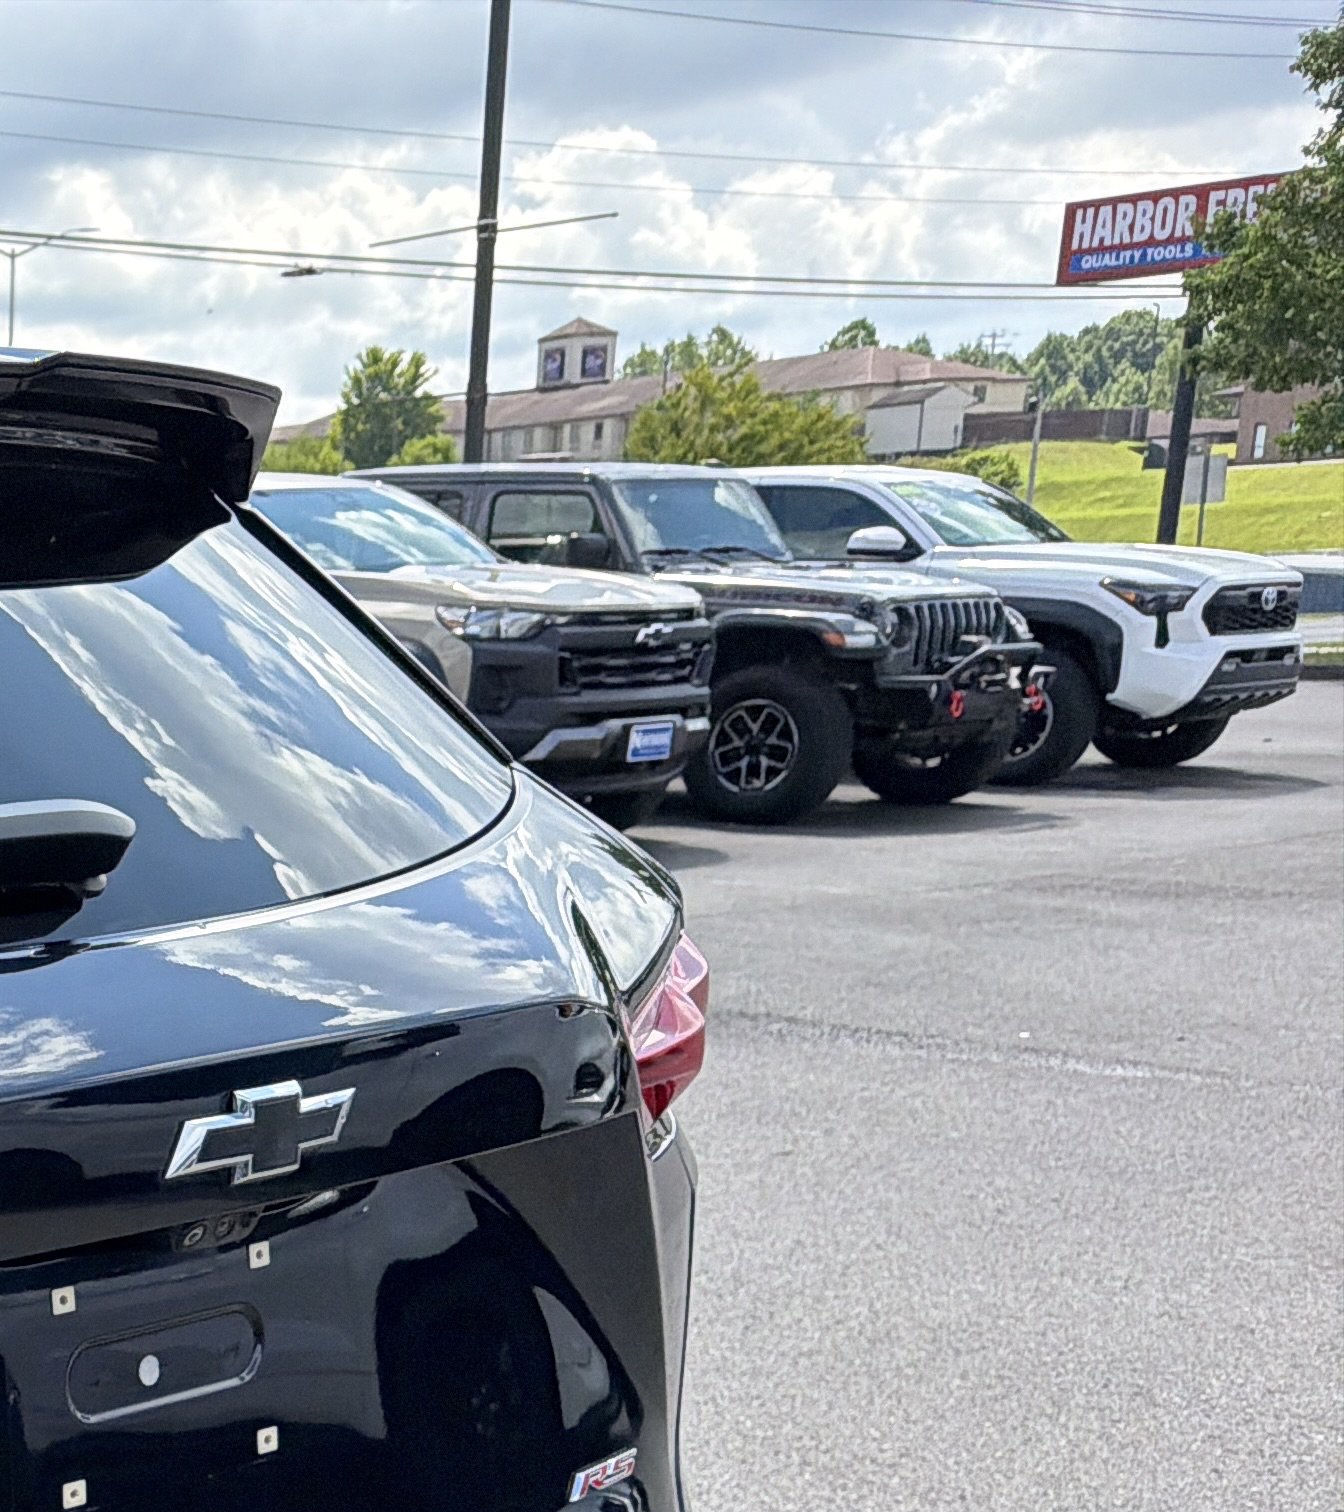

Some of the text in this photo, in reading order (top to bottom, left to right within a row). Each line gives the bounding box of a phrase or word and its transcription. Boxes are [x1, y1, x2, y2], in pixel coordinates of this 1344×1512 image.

[1072, 182, 1278, 250] HARBOR FRE
[1081, 250, 1141, 269] QUALITY
[1147, 243, 1193, 260] TOOLS
[569, 1448, 637, 1502] RS
